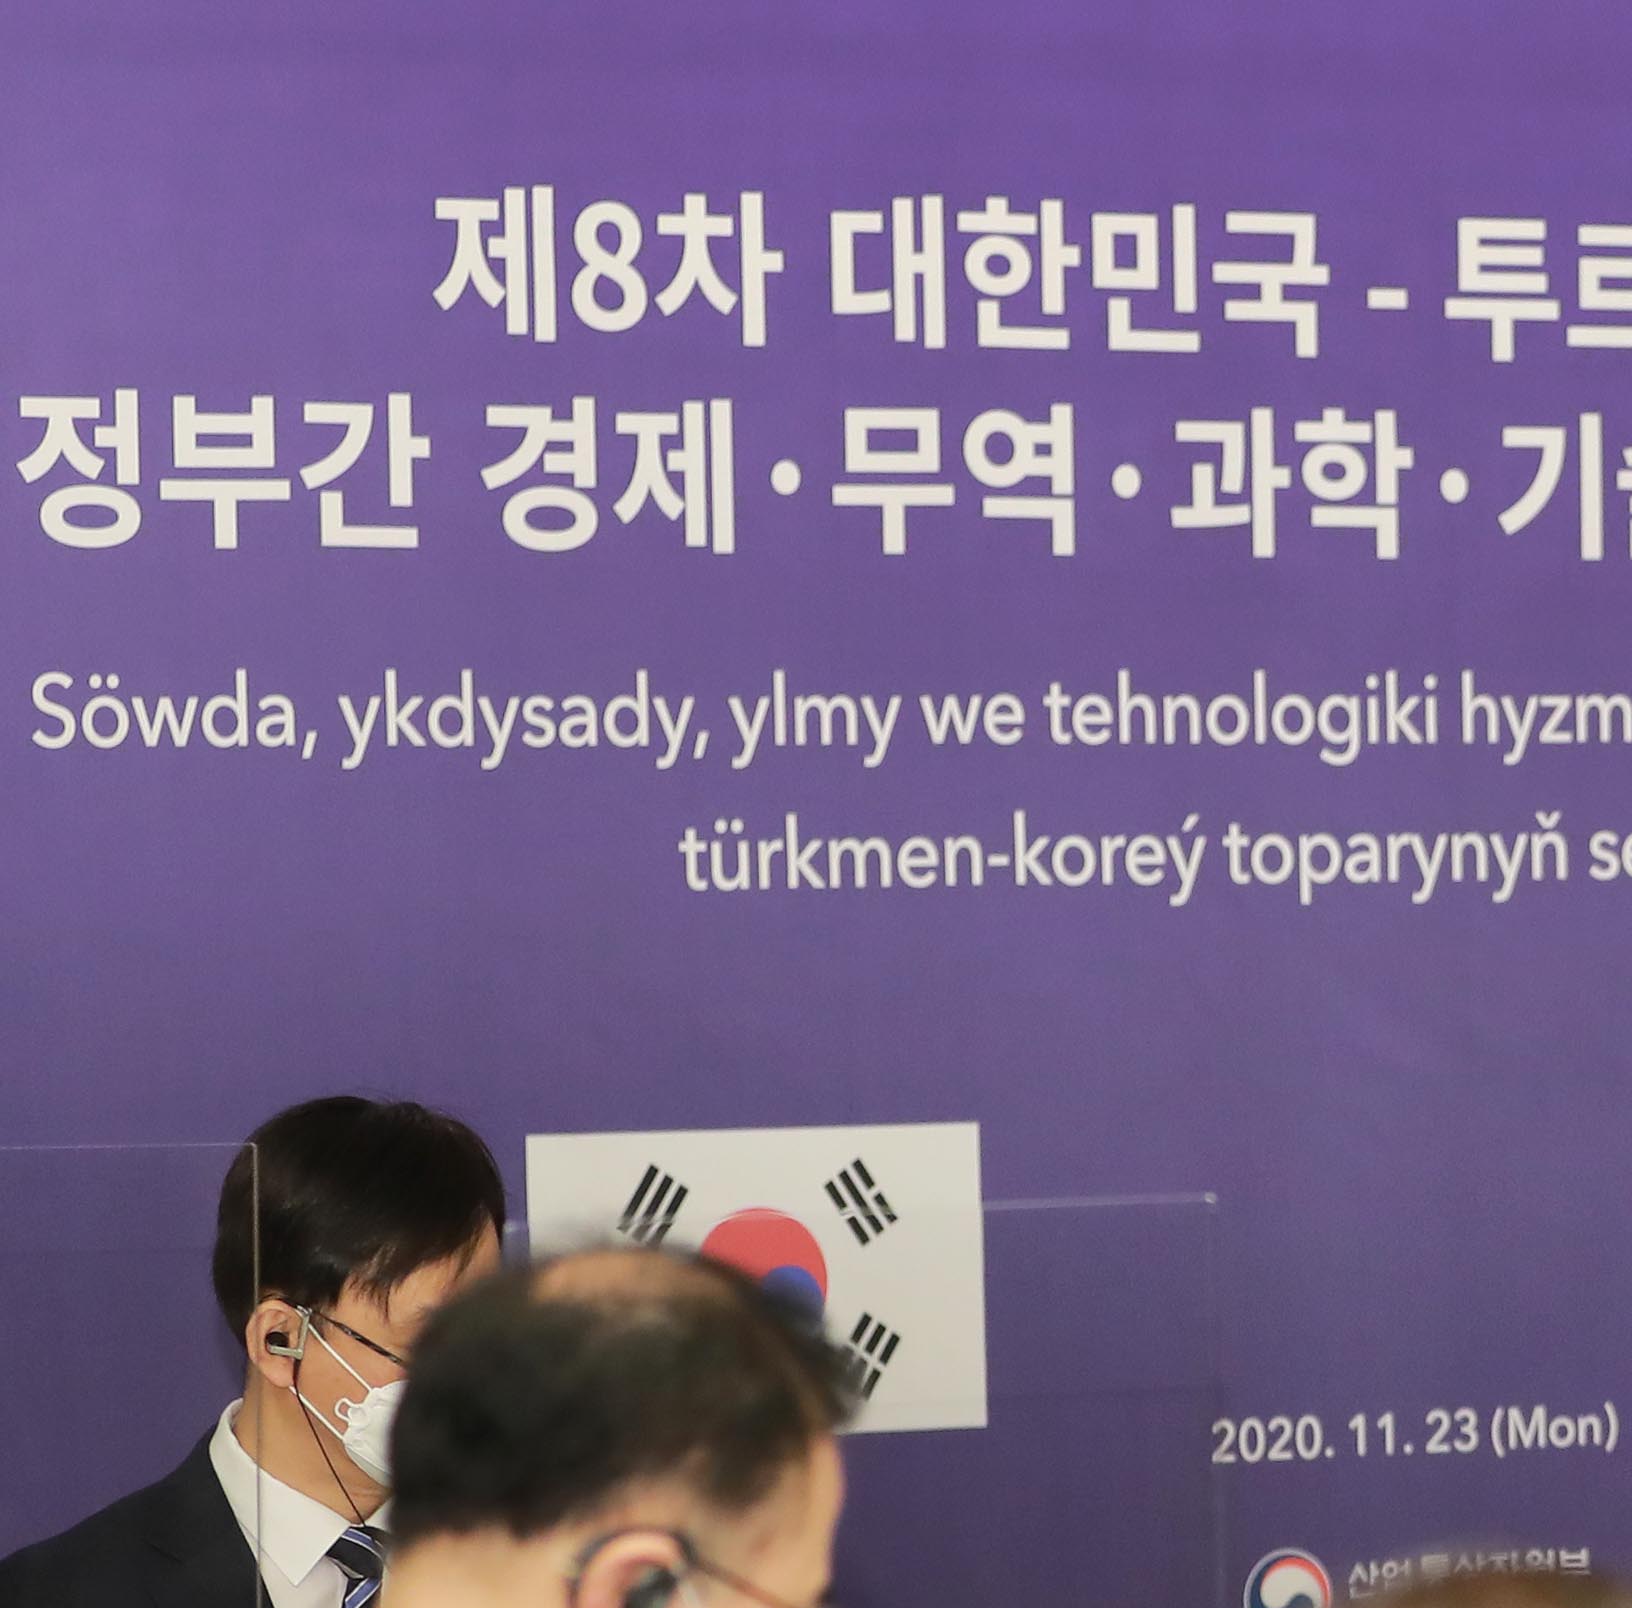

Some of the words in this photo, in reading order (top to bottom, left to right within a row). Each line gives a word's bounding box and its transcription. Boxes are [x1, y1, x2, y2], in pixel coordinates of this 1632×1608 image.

[432, 184, 785, 348] 제8차
[829, 194, 1330, 359] 대한민국
[15, 387, 432, 550] 정부간
[31, 667, 318, 760] Söwda,
[337, 668, 710, 771] ykdysady,
[727, 669, 902, 770] ylmy
[919, 693, 1026, 746] we
[1042, 668, 1438, 767] tehnologiki
[677, 809, 1207, 908] türkmen-koreý
[1221, 810, 1568, 906] toparynyň
[1490, 1400, 1620, 1459] (Mon)
